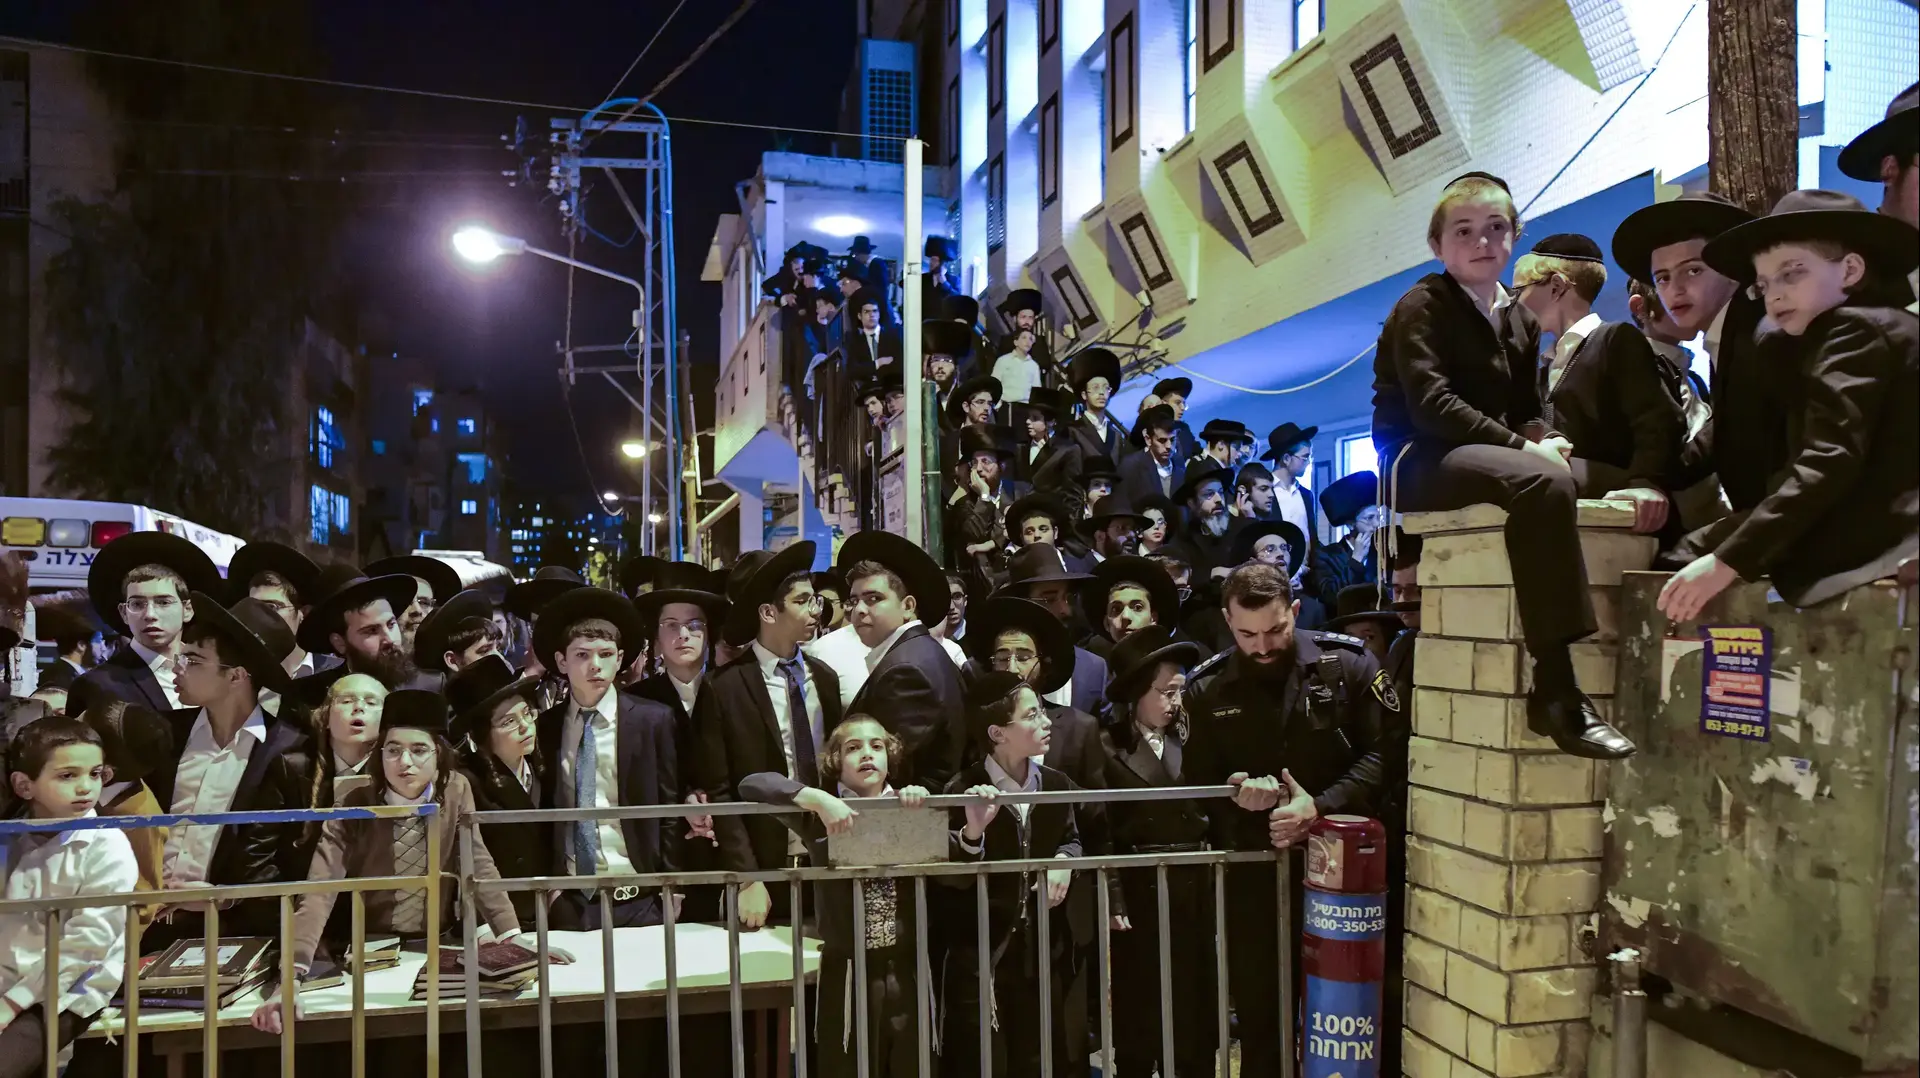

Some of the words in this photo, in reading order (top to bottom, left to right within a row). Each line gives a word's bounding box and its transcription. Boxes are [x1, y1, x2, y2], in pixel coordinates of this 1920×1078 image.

[1311, 899, 1362, 918] התבשיל
[1312, 1012, 1374, 1036] 100%
[1309, 1035, 1374, 1060] ארוחה
